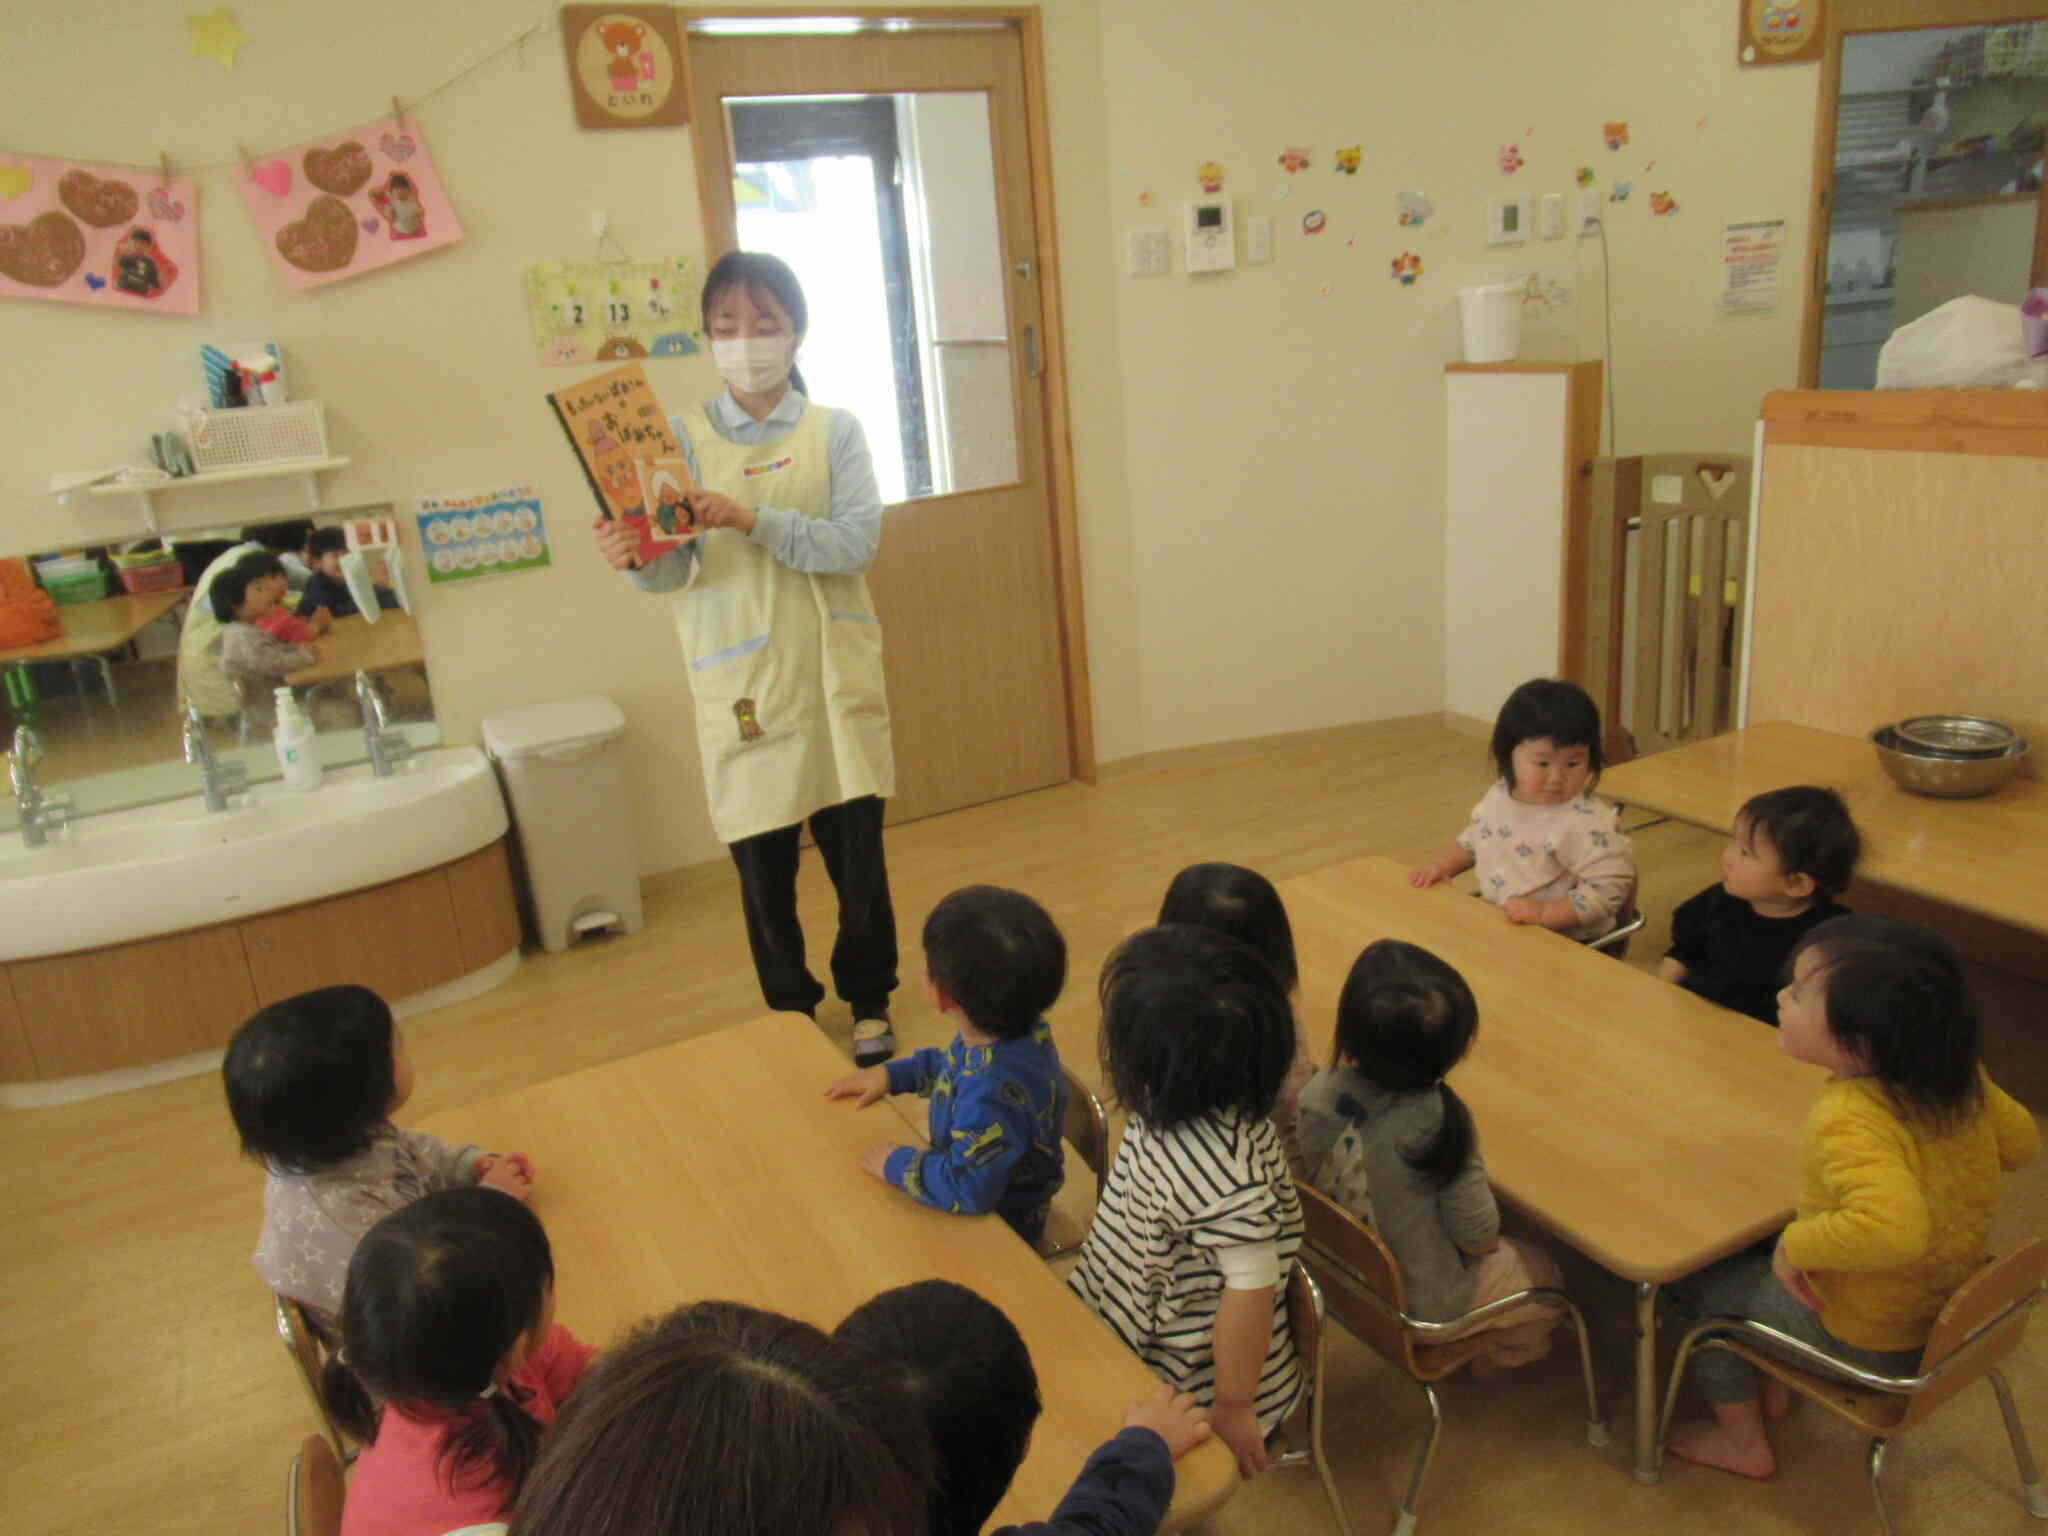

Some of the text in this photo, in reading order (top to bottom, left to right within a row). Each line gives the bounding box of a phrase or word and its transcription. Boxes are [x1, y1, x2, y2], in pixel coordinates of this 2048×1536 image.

[608, 93, 655, 106] といれ
[573, 304, 583, 324] 2
[608, 303, 630, 322] 13
